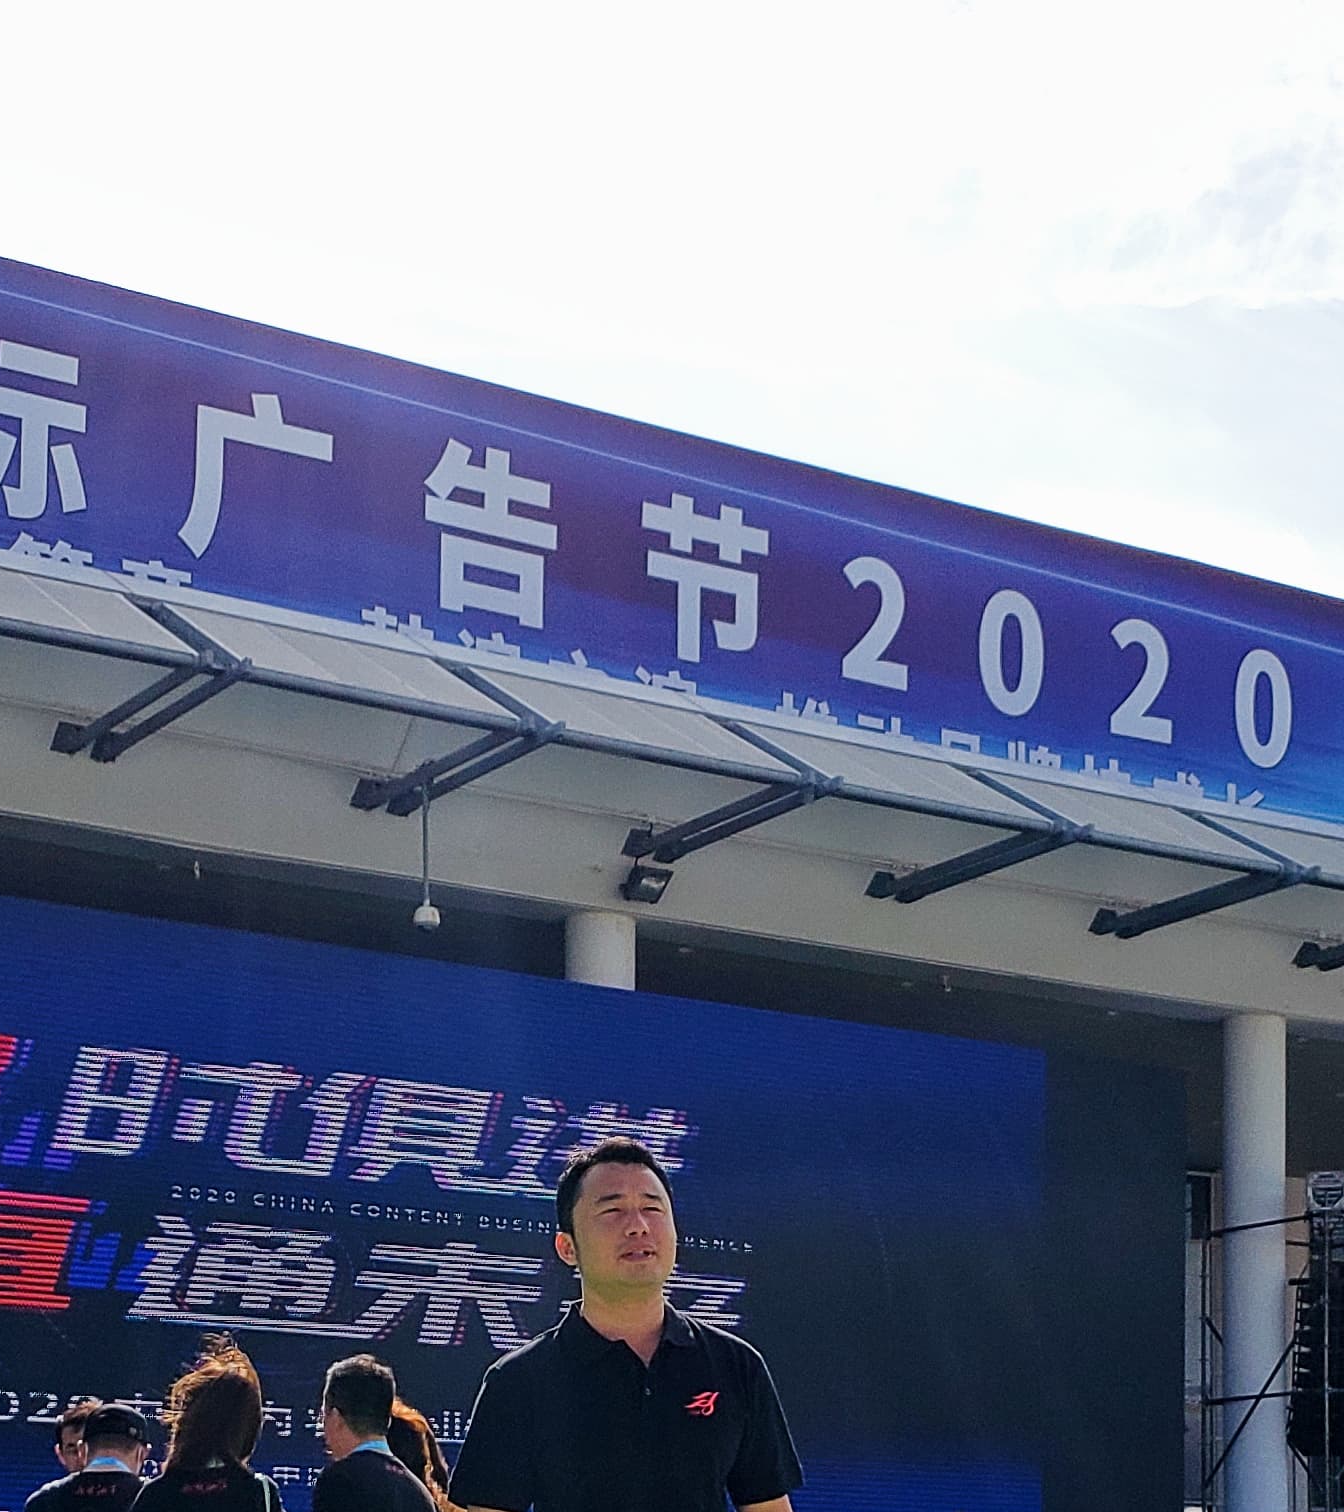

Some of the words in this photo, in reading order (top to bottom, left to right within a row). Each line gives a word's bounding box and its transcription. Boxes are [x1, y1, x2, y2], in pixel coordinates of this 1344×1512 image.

[171, 1185, 237, 1204] 2020
[253, 1193, 335, 1215] CHINA
[350, 1202, 464, 1227] CONTENT
